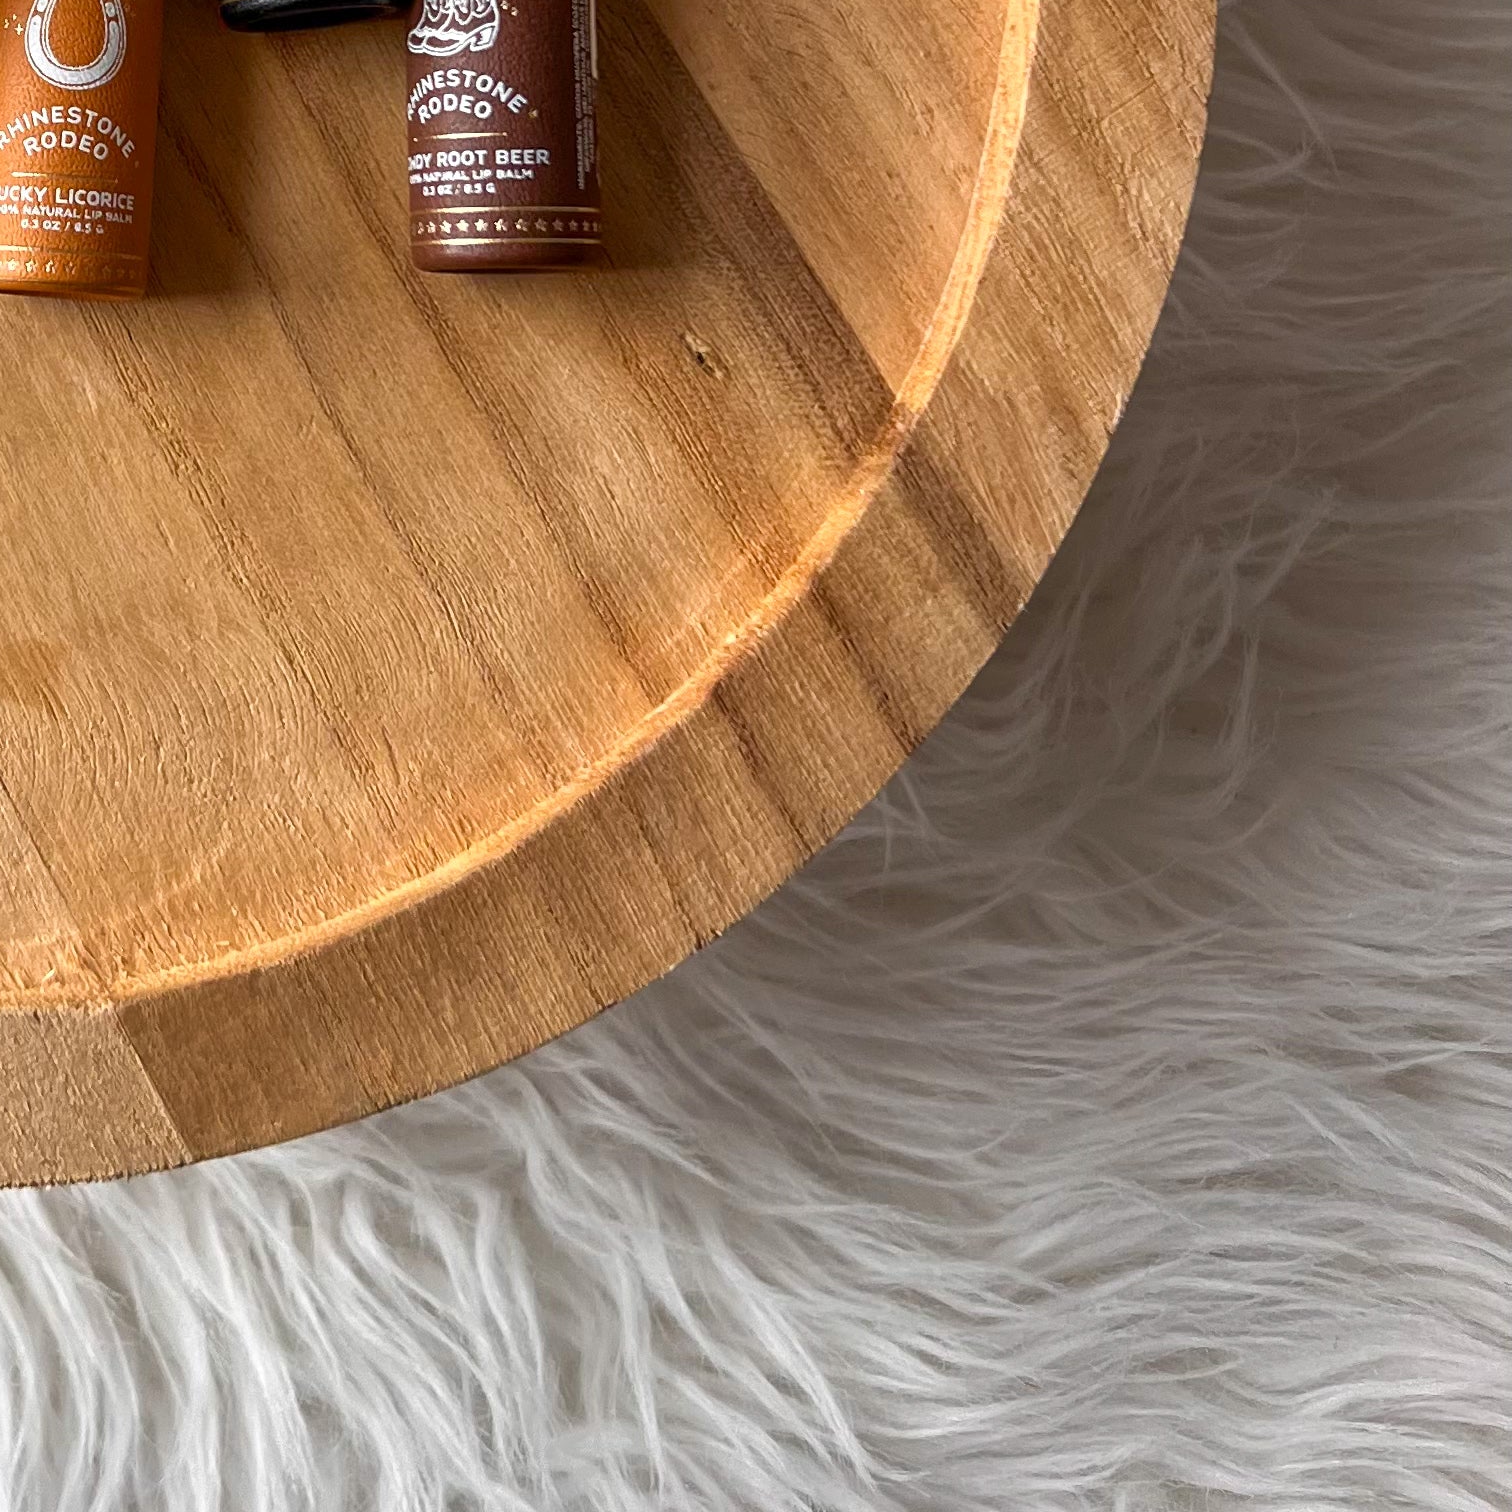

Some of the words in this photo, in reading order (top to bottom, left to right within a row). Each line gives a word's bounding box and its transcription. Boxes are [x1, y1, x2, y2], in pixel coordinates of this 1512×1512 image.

[417, 93, 493, 124] RODEO
[22, 130, 109, 161] RODEO
[436, 149, 488, 168] ROOT
[495, 148, 551, 165] BEER
[471, 169, 493, 181] LIP
[496, 168, 534, 180] BALM
[485, 182, 496, 193] G
[55, 188, 135, 211] LICORICE
[23, 205, 80, 219] NATURAL
[84, 210, 103, 220] LIP
[106, 212, 133, 224] BALM
[42, 220, 61, 231] OZ
